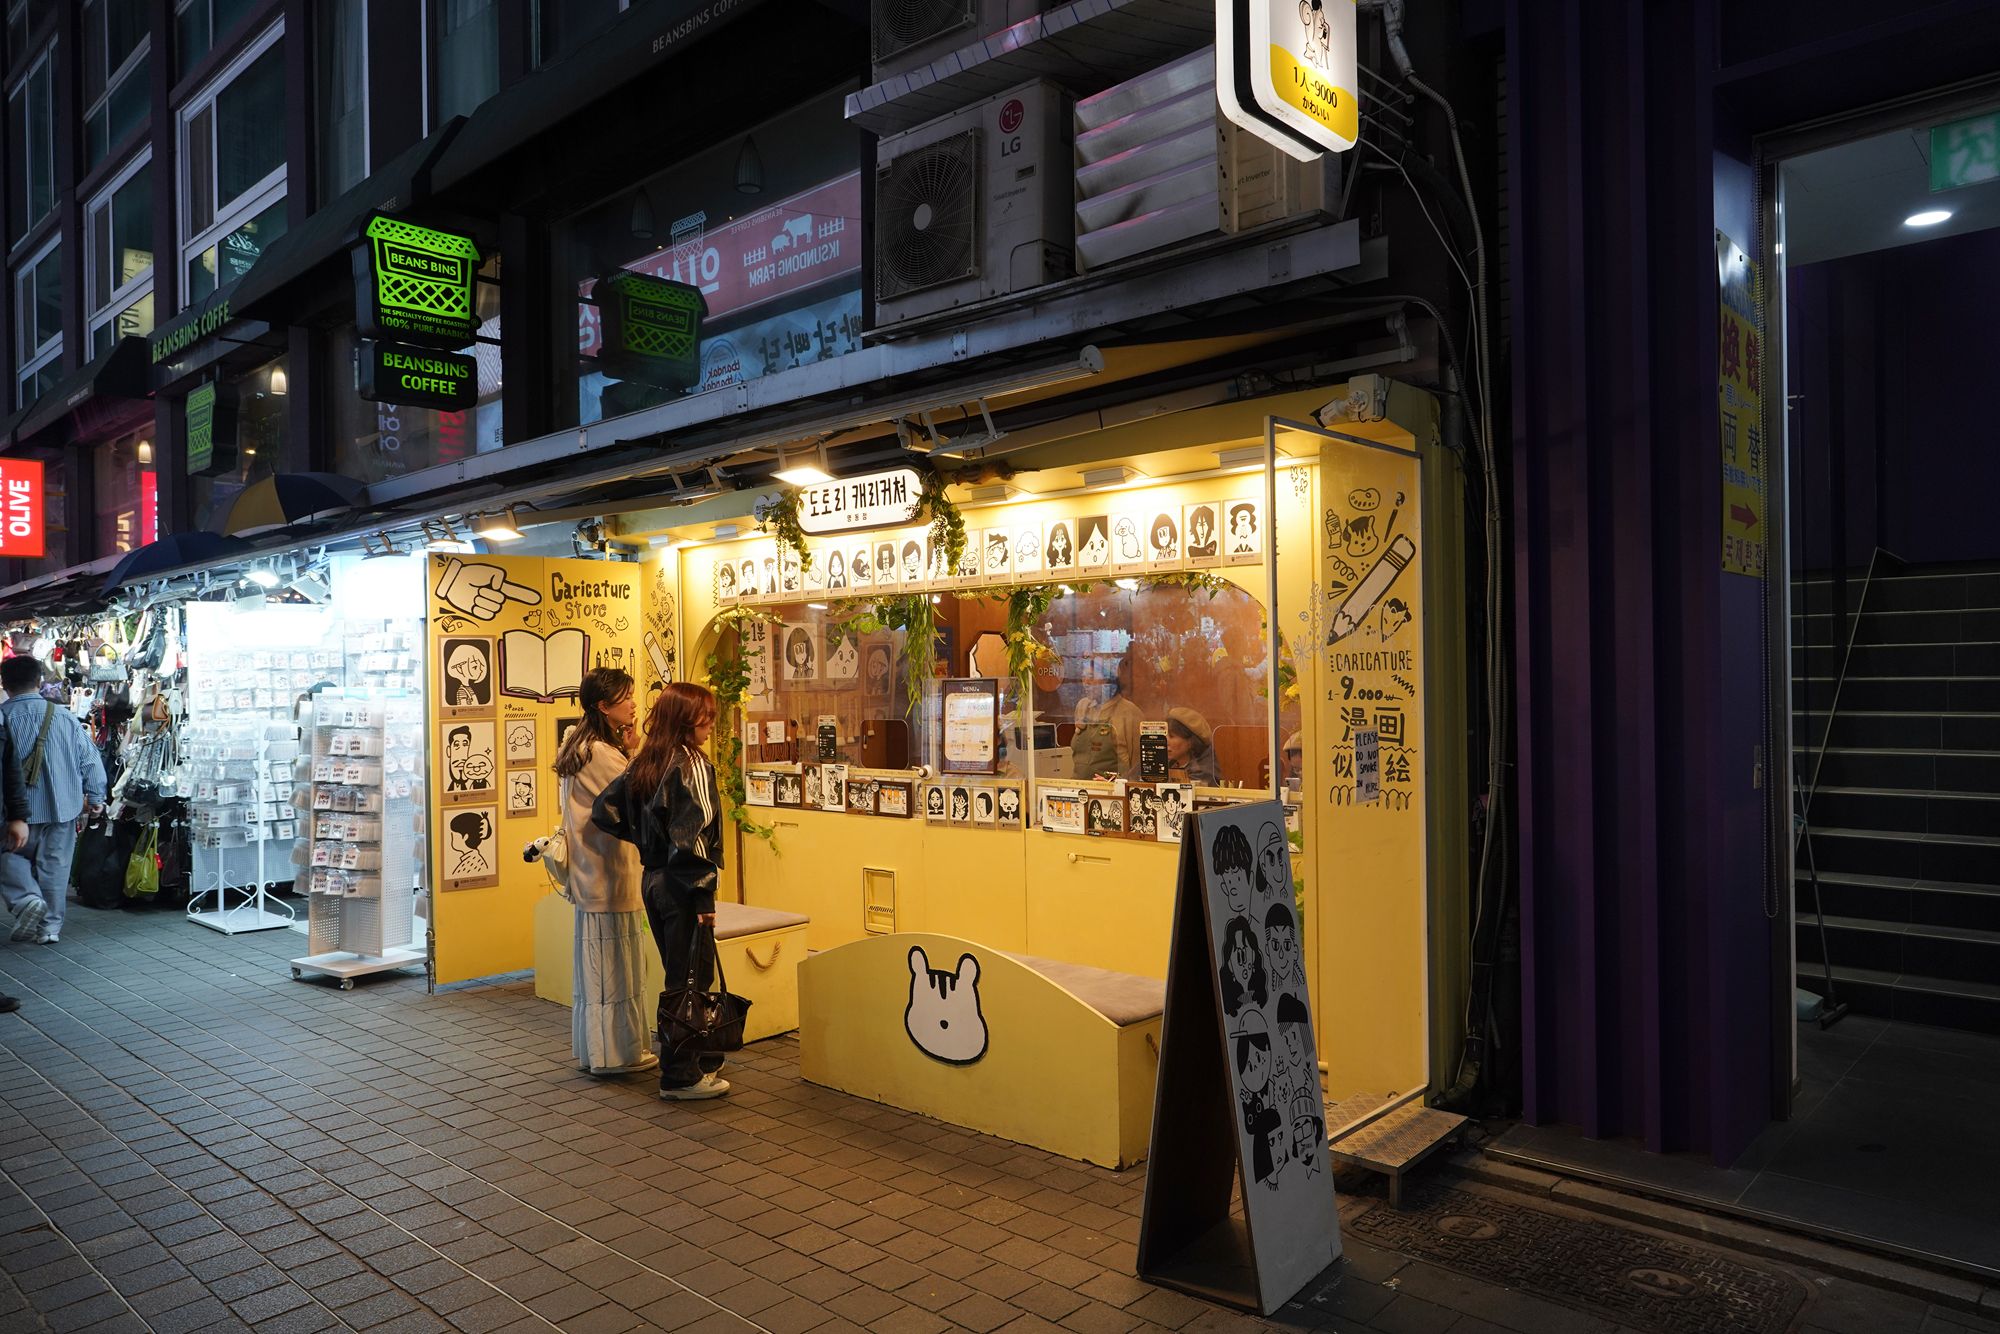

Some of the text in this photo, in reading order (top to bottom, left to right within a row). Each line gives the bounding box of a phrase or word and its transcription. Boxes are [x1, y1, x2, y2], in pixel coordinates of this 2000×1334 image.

[652, 8, 710, 53] BEANSBINS
[1302, 95, 1330, 121] かわいい
[1001, 136, 1022, 158] LG
[391, 252, 457, 276] BEANS BINS
[380, 315, 471, 340] 100% PURE ARABICA
[381, 307, 392, 315] THE
[392, 309, 422, 321] SPECIALTY
[422, 315, 443, 325] COFFEE
[152, 299, 232, 365] BEANSBINS COFFE
[383, 352, 469, 379] BEANSBINS
[401, 374, 457, 396] COFFEE
[810, 485, 847, 517] 도토리
[852, 475, 907, 509] 캐리커쳐
[9, 480, 31, 537] OLIVE
[551, 571, 631, 603] Caricature
[565, 601, 607, 619] Store
[751, 622, 766, 641] 1분
[1335, 650, 1413, 672] CARICATURE
[1355, 732, 1378, 746] PLEASE
[1332, 752, 1411, 784] 似絵
[1355, 751, 1364, 762] DO
